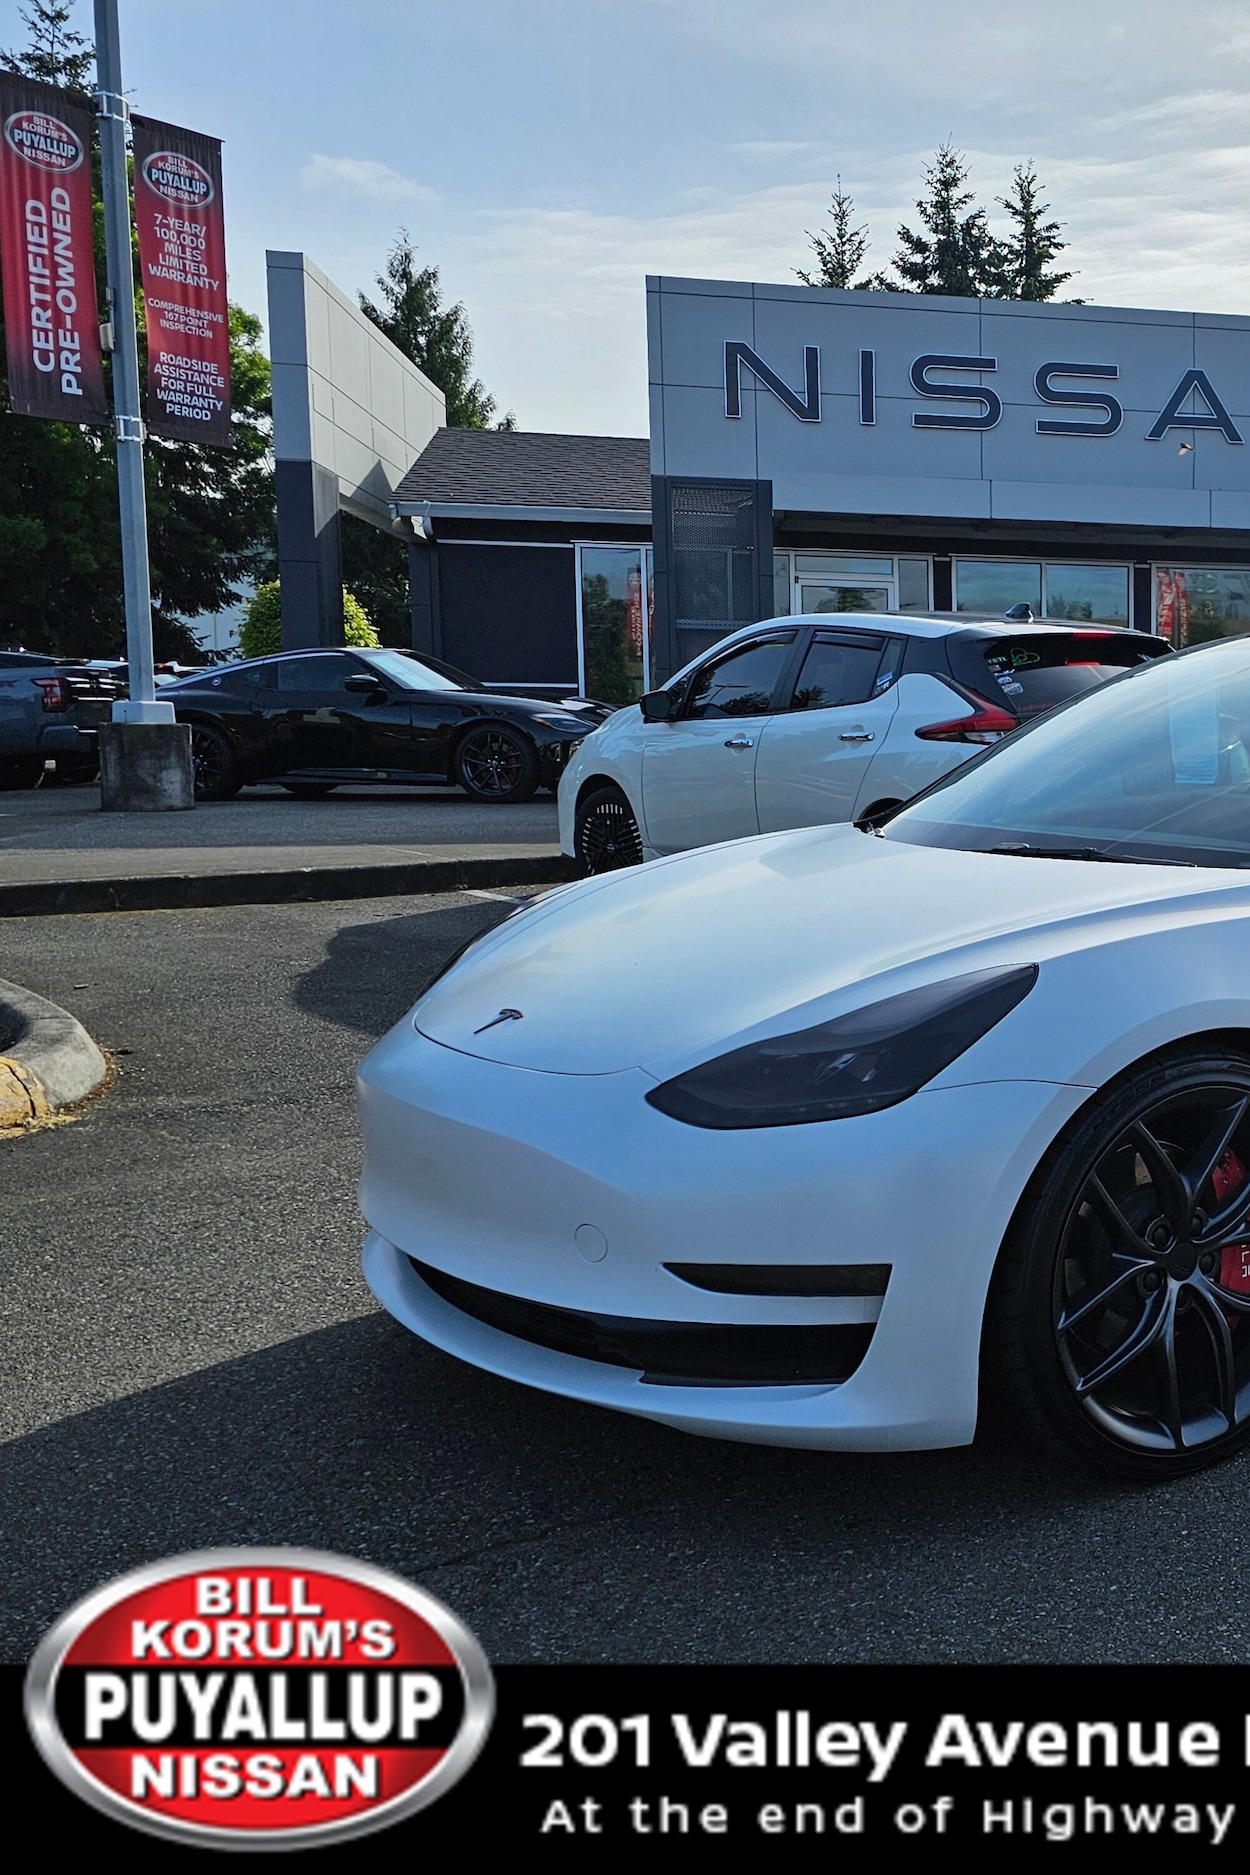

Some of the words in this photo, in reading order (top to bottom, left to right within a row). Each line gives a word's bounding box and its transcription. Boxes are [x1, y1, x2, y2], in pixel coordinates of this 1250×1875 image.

[22, 121, 67, 140] KORUM'S
[33, 115, 55, 128] BILL
[13, 128, 75, 157] PUYALLUP
[23, 146, 65, 165] NISSAN
[167, 156, 187, 167] BILL
[158, 160, 199, 178] KORUM'S
[151, 168, 207, 194] PUYALLUP
[160, 185, 198, 202] NISSAN
[153, 213, 206, 237] 7-YEAR/
[153, 227, 205, 249] 100,000
[164, 241, 201, 260] MILES
[159, 253, 207, 275] LIMITED
[25, 198, 55, 372] CERTIFIED
[148, 263, 218, 290] WARRANTY
[50, 187, 83, 395] PRE-OWNED
[148, 298, 224, 323] COMPREHENSIVE
[163, 311, 179, 321] 167
[180, 314, 208, 328] POINT
[160, 319, 212, 338] INSPECTION
[160, 351, 218, 374] ROADSIDE
[153, 363, 224, 387] ASSISTANCE
[161, 376, 184, 391] FOR
[186, 382, 216, 398] FULL
[156, 388, 223, 410] WARRANTY
[166, 402, 211, 420] PERIOD
